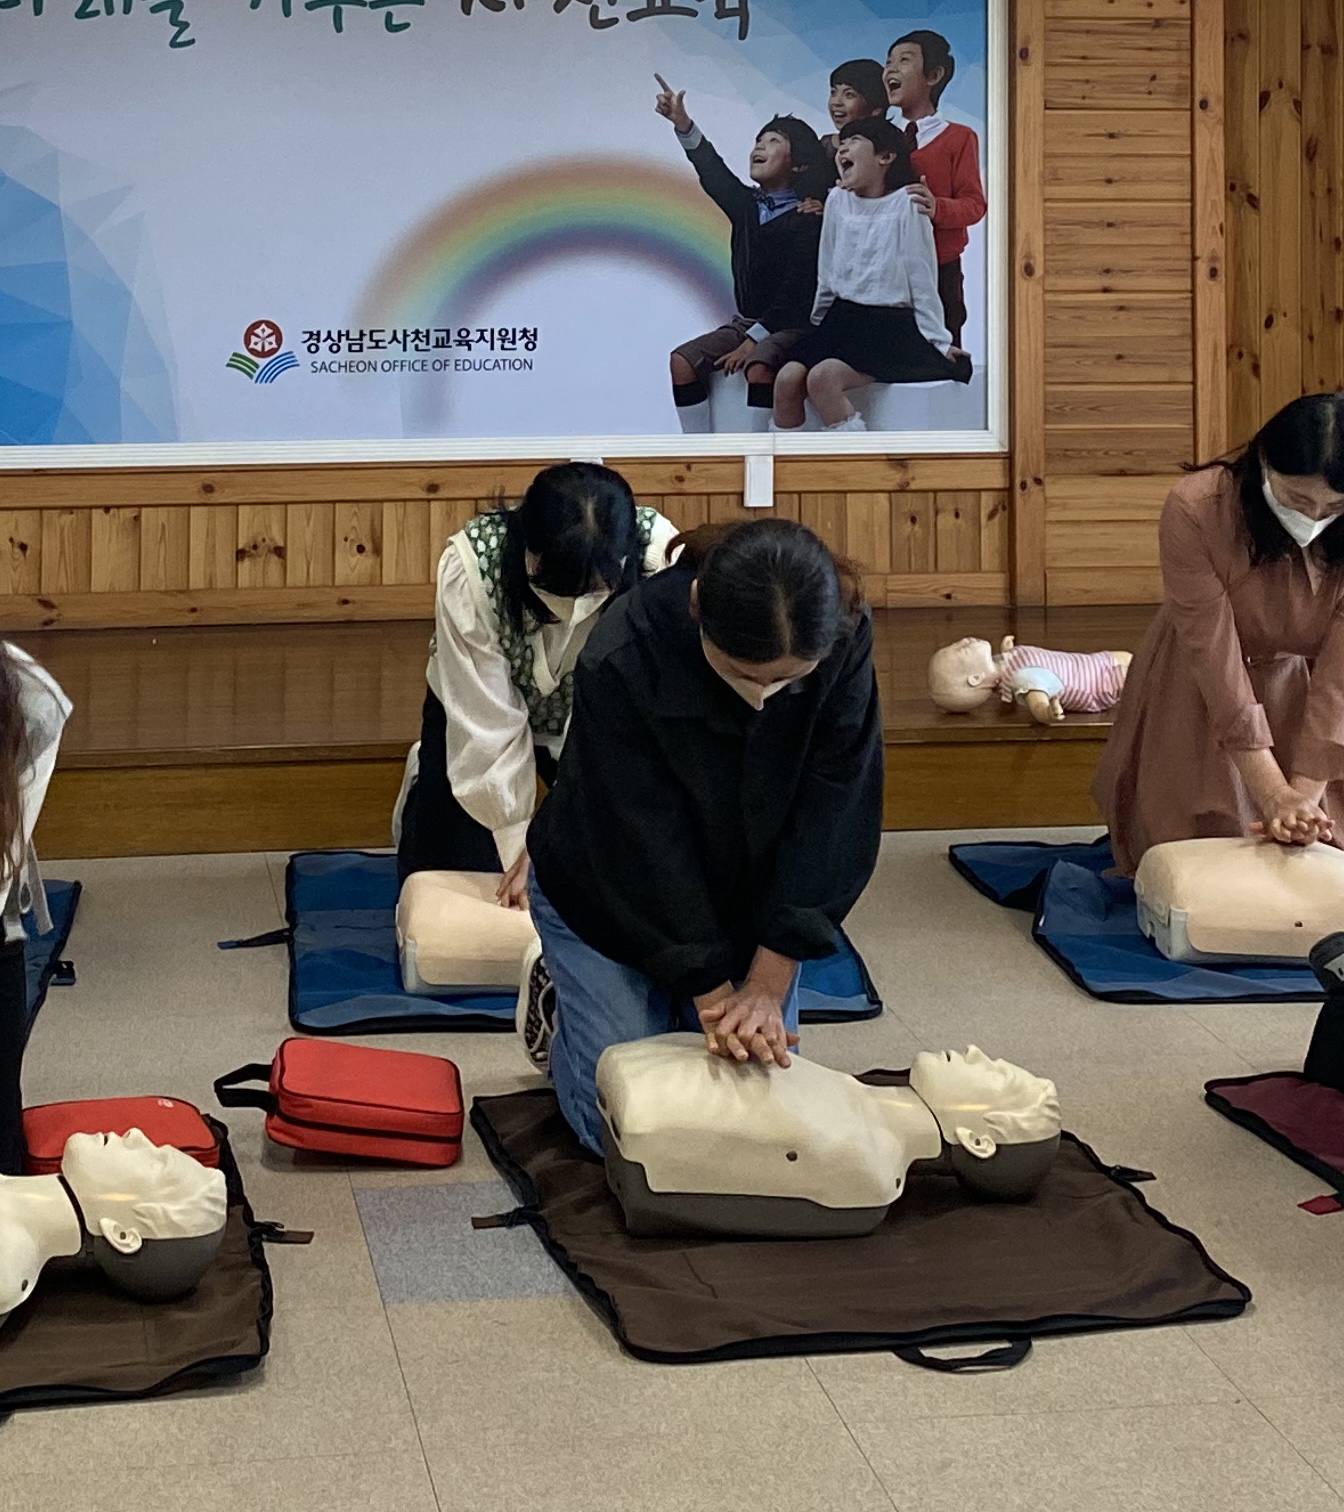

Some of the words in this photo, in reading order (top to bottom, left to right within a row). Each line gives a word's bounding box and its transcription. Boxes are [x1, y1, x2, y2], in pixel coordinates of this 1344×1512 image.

[301, 327, 538, 354] 경상남도사천교육지원청
[310, 359, 378, 373] SACHEON
[380, 359, 429, 373] OFFICE
[432, 357, 451, 372] OF
[453, 356, 533, 372] EDUCATION
